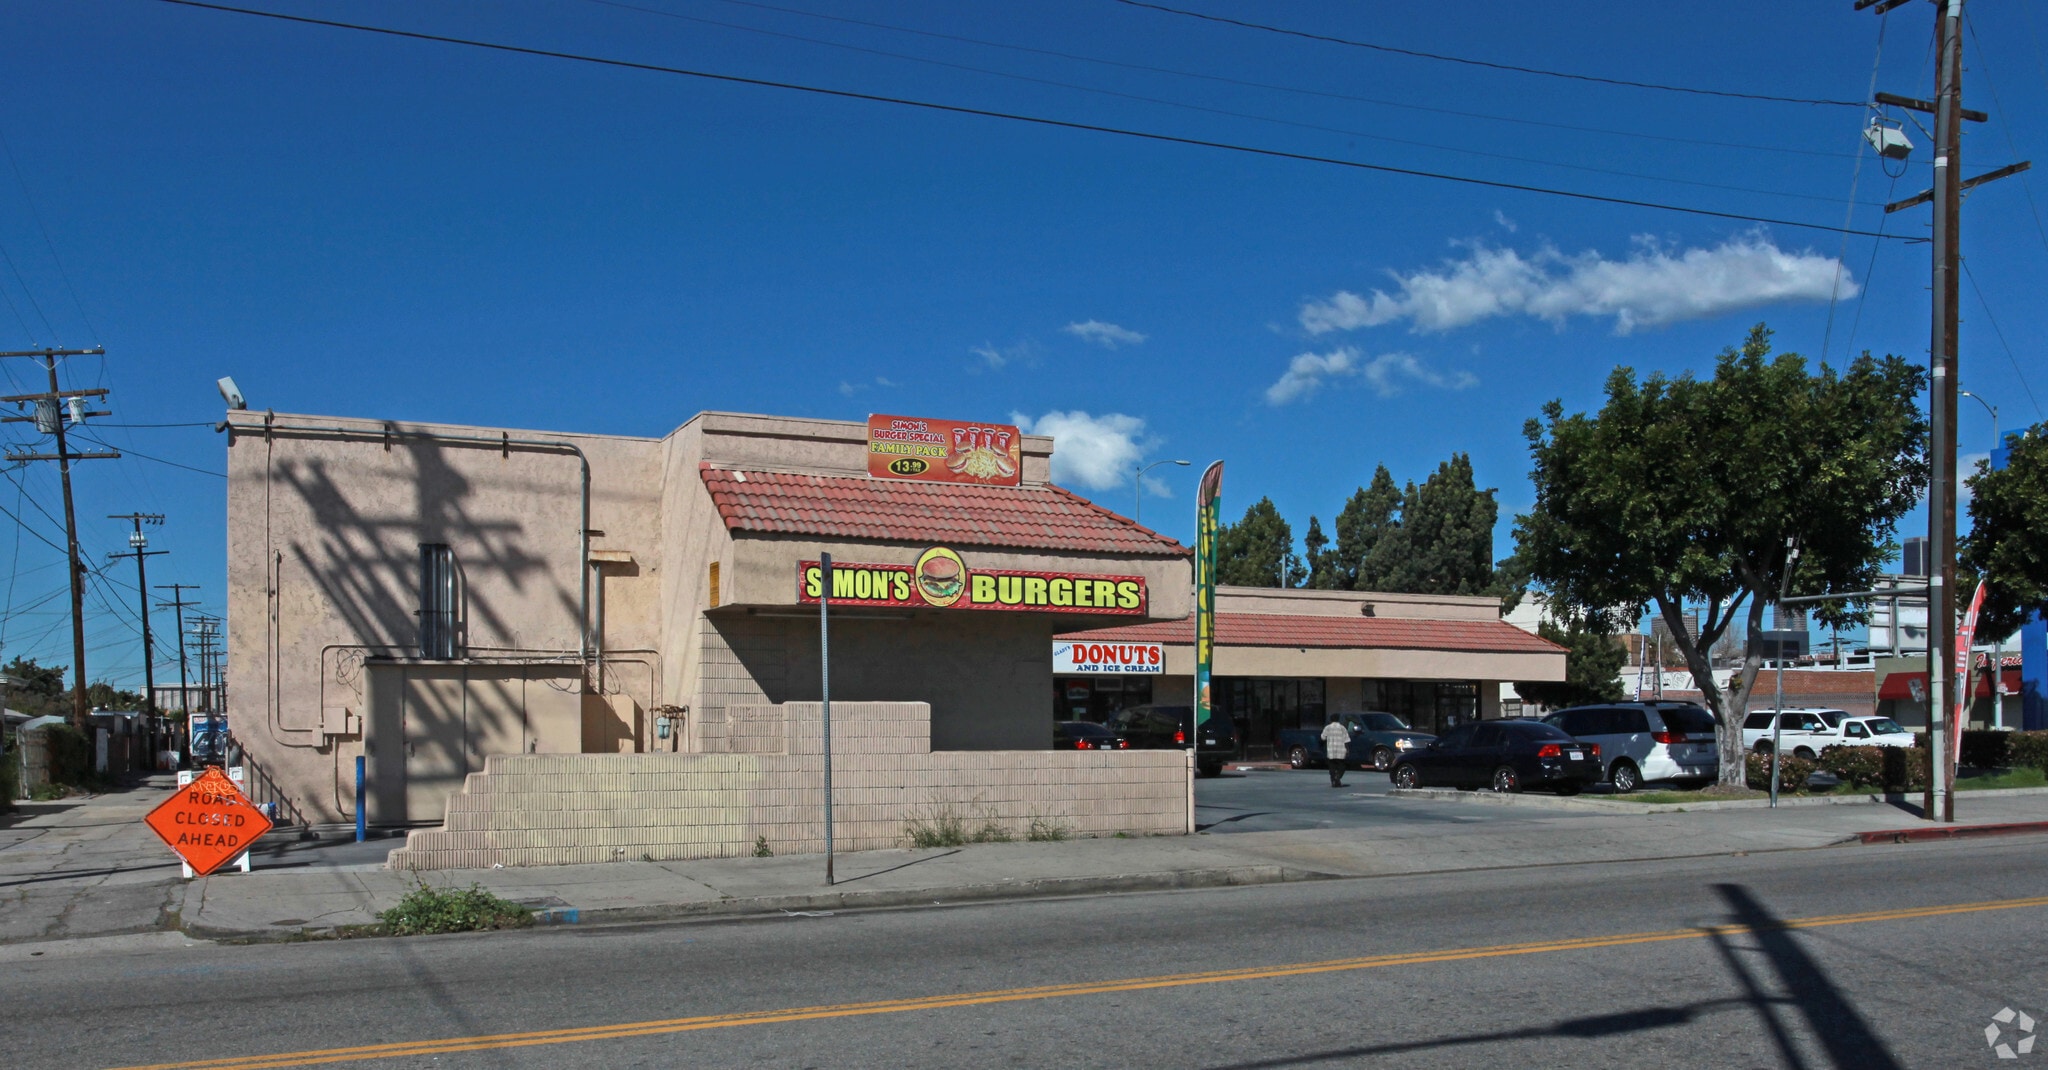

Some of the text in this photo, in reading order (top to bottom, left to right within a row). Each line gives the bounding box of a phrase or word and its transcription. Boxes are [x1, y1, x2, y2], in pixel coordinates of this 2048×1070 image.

[892, 421, 927, 431] SIMON'S
[874, 430, 945, 444] BURGER SPECIAL
[871, 442, 947, 457] FAMILY PACK
[806, 567, 1140, 609] SMON'S BURGERS
[1072, 644, 1160, 665] DONUTS
[1124, 665, 1160, 673] CREAM
[189, 791, 236, 806] ROAD
[175, 811, 245, 827] CLOSED
[177, 832, 238, 847] AHEAD
